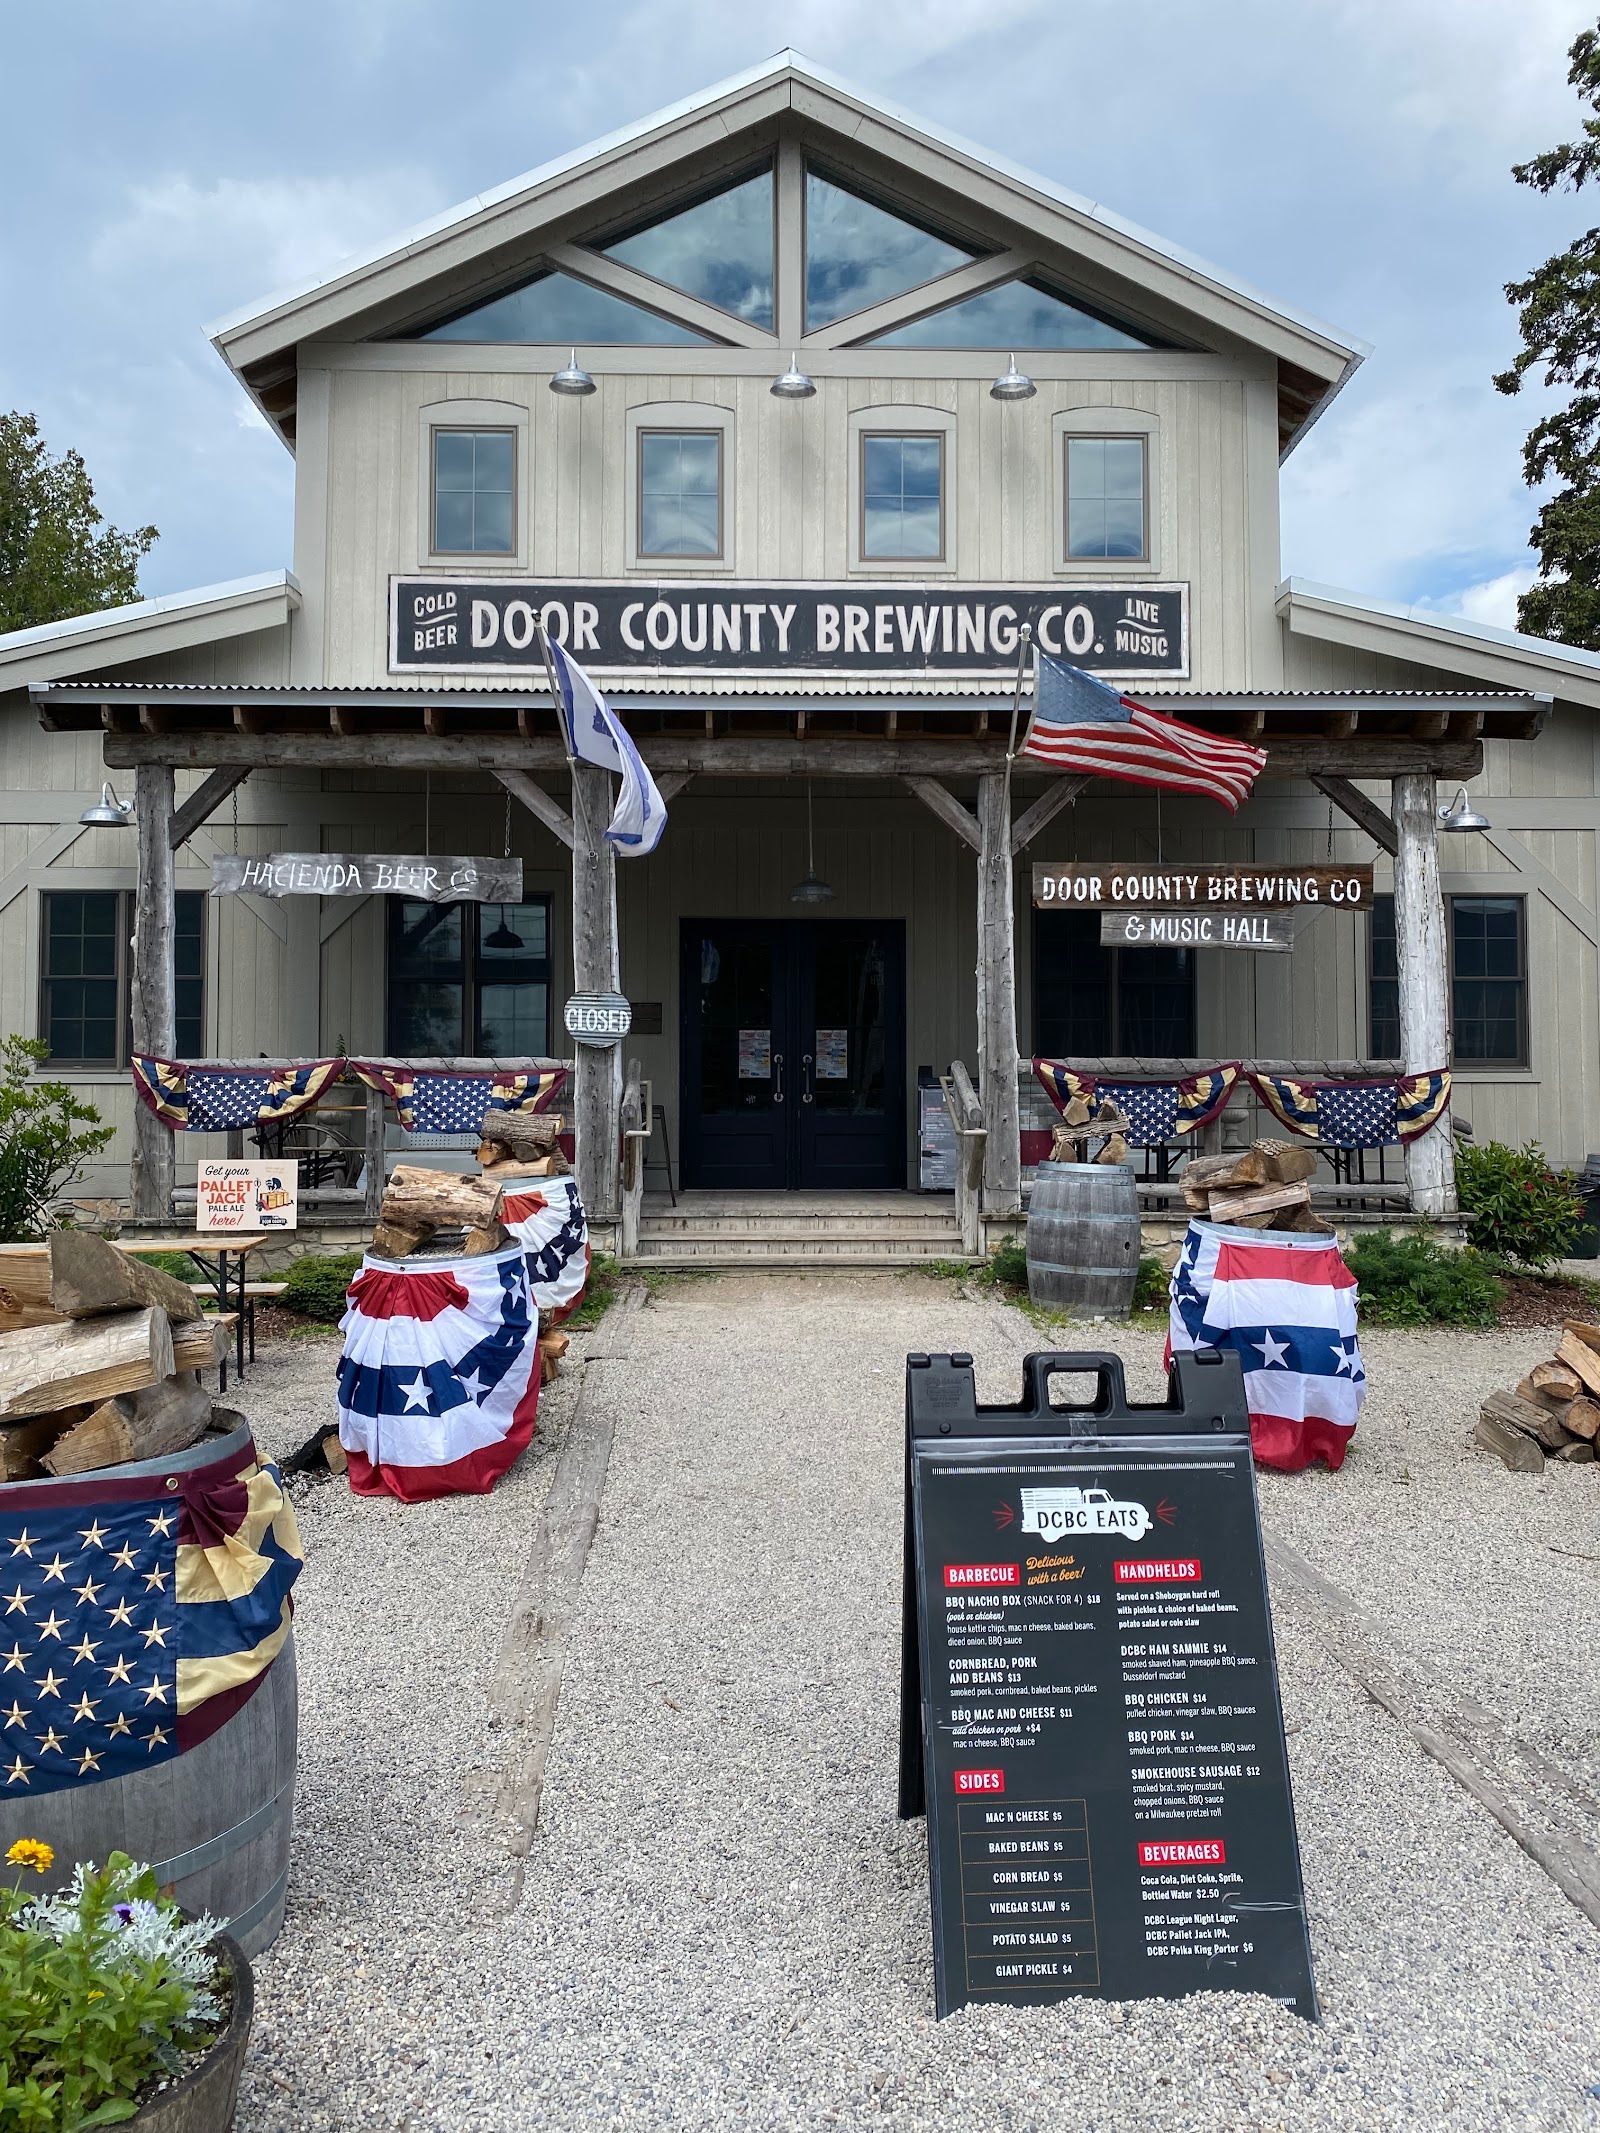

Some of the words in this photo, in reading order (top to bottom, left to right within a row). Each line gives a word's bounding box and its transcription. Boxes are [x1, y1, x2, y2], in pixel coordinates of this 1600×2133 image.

[414, 592, 456, 617] COLD
[1125, 598, 1160, 623] LIVE
[471, 600, 600, 651] DOOR
[620, 602, 797, 652] COUNTY
[816, 604, 1018, 655] BREWING
[1038, 605, 1105, 654] CO.
[414, 625, 457, 651] BEER
[1116, 630, 1168, 657] MUSIC
[242, 860, 361, 889] HACIENDA
[372, 864, 442, 890] BEER
[1043, 877, 1100, 900] DOOR
[1111, 876, 1198, 900] COUNTY
[1208, 877, 1319, 901] BREWING
[1330, 879, 1361, 902] CO
[1125, 916, 1144, 940] &
[1151, 918, 1211, 941] MUSIC
[1224, 919, 1273, 943] HALL
[566, 1008, 630, 1032] CLOSED
[206, 1166, 223, 1175] Get
[224, 1168, 249, 1180] your
[201, 1181, 253, 1192] PALLET
[207, 1193, 246, 1204] JACK
[209, 1214, 243, 1226] here!
[1037, 1511, 1087, 1528] DCBC
[1097, 1510, 1138, 1527] EATS
[1026, 1555, 1075, 1570] Delicious
[950, 1568, 1014, 1582] BARBECUE
[1027, 1572, 1050, 1585] with
[1051, 1574, 1058, 1582] a
[1059, 1567, 1085, 1581] beer!
[1120, 1563, 1195, 1578] HANDHELDS
[946, 1596, 964, 1609] BBQ
[968, 1596, 999, 1606] NACHO
[1003, 1595, 1021, 1606] BOX
[1024, 1594, 1053, 1607] (SNACK
[1056, 1595, 1071, 1604] FOR
[1074, 1594, 1083, 1605] 4)
[1087, 1594, 1100, 1604] $18
[948, 1625, 966, 1633] house
[968, 1624, 986, 1633] kettle
[1054, 1622, 1073, 1630] baked
[1075, 1622, 1096, 1630] beans,
[1121, 1645, 1146, 1656] DCBC
[1149, 1644, 1169, 1655] HAM
[1172, 1643, 1209, 1654] SAMMIE
[1214, 1644, 1227, 1654] $14
[949, 1658, 1009, 1670] CORNBREAD,
[1012, 1657, 1037, 1668] PORK
[1122, 1659, 1147, 1669] smoked
[1148, 1659, 1171, 1667] shaved
[1172, 1659, 1188, 1667] ham,
[1189, 1657, 1220, 1668] pineapple
[1222, 1656, 1236, 1667] BBQ
[950, 1673, 969, 1684] AND
[972, 1672, 1003, 1683] BEANS
[1008, 1673, 1021, 1683] $13
[1123, 1671, 1157, 1681] Dusseldorf
[1159, 1671, 1186, 1680] mustard
[951, 1687, 975, 1696] smoked
[1032, 1685, 1050, 1694] baked
[1075, 1684, 1097, 1694] pickles
[1125, 1695, 1145, 1707] BBQ
[1147, 1693, 1189, 1704] CHICKEN
[1193, 1694, 1207, 1703] $14
[952, 1710, 971, 1723] BBQ
[974, 1709, 994, 1720] MAC
[997, 1709, 1016, 1720] AND
[1019, 1707, 1055, 1719] CHEESE
[1060, 1708, 1073, 1718] $11
[1126, 1708, 1146, 1720] pulled
[1148, 1708, 1174, 1717] chicken,
[1176, 1707, 1199, 1717] vinegar
[1201, 1707, 1217, 1715] slaw,
[1218, 1706, 1232, 1716] BBQ
[1233, 1706, 1256, 1714] sauces
[1128, 1731, 1148, 1744] BBQ
[1151, 1730, 1176, 1742] PORK
[1181, 1731, 1194, 1741] $14
[1130, 1745, 1155, 1755] smoked
[1156, 1745, 1173, 1756] pork,
[1174, 1745, 1188, 1754] mac
[1221, 1743, 1235, 1753] BBQ
[1237, 1743, 1256, 1751] sauce
[1131, 1767, 1196, 1780] SMOKEHOUSE
[1200, 1765, 1242, 1777] SAUSAGE
[1247, 1766, 1260, 1776] $12
[960, 1773, 999, 1789] SIDES
[1134, 1797, 1162, 1807] chopped
[1189, 1795, 1203, 1806] BBQ
[986, 1812, 1004, 1823] MAC
[1008, 1812, 1014, 1822] N
[1016, 1811, 1049, 1822] CHEESE
[1053, 1812, 1062, 1821] $5
[1150, 1810, 1185, 1819] Milwaukee
[1187, 1808, 1209, 1819] pretzel
[1210, 1807, 1221, 1817] roll
[989, 1842, 1017, 1853] BAKED
[1020, 1841, 1049, 1852] BEANS
[1054, 1842, 1063, 1851] $5
[1144, 1844, 1219, 1861] BEVERAGES
[993, 1872, 1018, 1883] CORN
[1020, 1871, 1050, 1882] BREAD
[1054, 1872, 1063, 1882] $5
[1141, 1876, 1159, 1885] Coca
[1160, 1875, 1179, 1885] Cola,
[1181, 1874, 1196, 1883] Diet
[1197, 1874, 1217, 1884] Coke,
[1219, 1873, 1243, 1885] Sprite,
[1142, 1891, 1169, 1900] Bottled
[1171, 1890, 1192, 1899] Water
[1196, 1889, 1219, 1899] $2.50
[990, 1902, 1028, 1914] VINEGAR
[1031, 1901, 1056, 1912] SLAW
[1061, 1902, 1070, 1912] $5
[1145, 1915, 1165, 1925] DCBC
[1166, 1915, 1192, 1926] League
[1194, 1914, 1215, 1925] Night
[1216, 1913, 1238, 1924] Lager,
[993, 1934, 1026, 1945] POTATO
[1029, 1933, 1058, 1944] SALAD
[1062, 1934, 1072, 1944] $5
[1146, 1931, 1167, 1940] DCBC
[1169, 1930, 1192, 1939] Pallet
[1194, 1929, 1212, 1939] Jack
[1214, 1928, 1229, 1938] IPA,
[1147, 1946, 1168, 1956] DCBC
[1171, 1945, 1192, 1955] Polka
[1194, 1945, 1212, 1955] King
[1214, 1944, 1239, 1953] Porter
[1243, 1942, 1253, 1953] $6
[996, 1965, 1023, 1977] GIANT
[1026, 1964, 1058, 1975] PICKLE
[1063, 1965, 1072, 1974] $4
